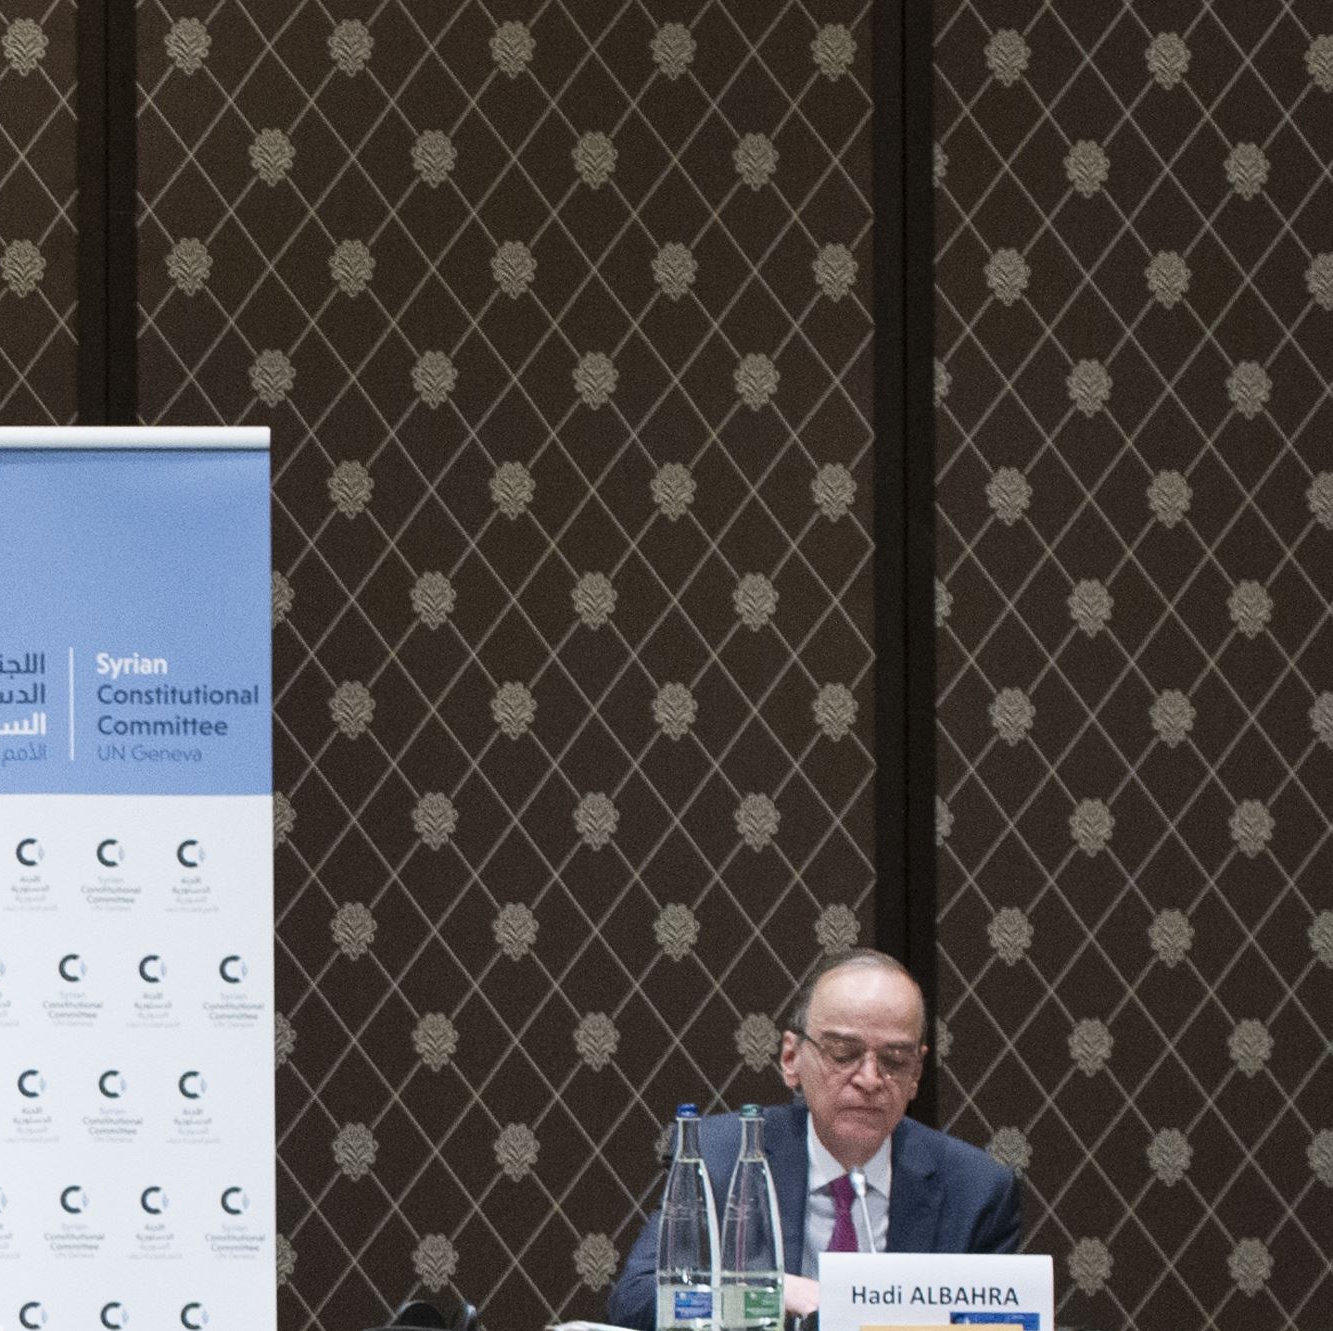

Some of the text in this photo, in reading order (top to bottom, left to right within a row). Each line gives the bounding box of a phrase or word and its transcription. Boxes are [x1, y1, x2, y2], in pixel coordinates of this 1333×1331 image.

[97, 653, 167, 679] Syrian
[98, 685, 258, 704] Constitutional
[98, 716, 228, 736] Committee
[98, 744, 202, 762] UN Geneva
[852, 1286, 1018, 1305] Hadi ALBAHRA
